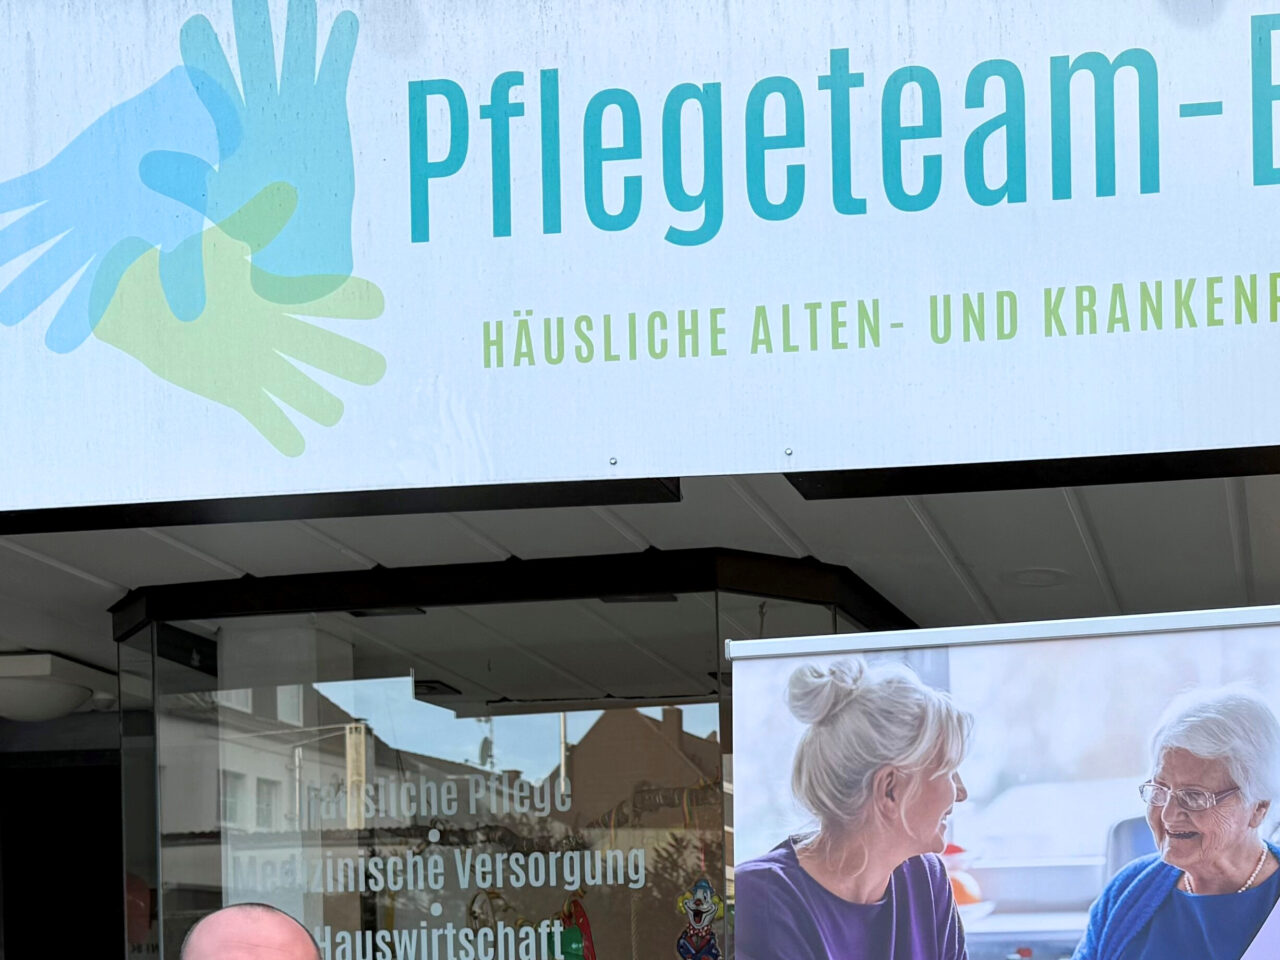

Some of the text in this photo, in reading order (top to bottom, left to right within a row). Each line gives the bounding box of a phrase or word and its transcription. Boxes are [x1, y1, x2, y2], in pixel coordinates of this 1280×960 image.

[483, 307, 728, 369] HÄUSLICHE
[750, 298, 905, 356] ALTEN-
[929, 289, 1019, 345] UND
[454, 847, 646, 891] Versorgung
